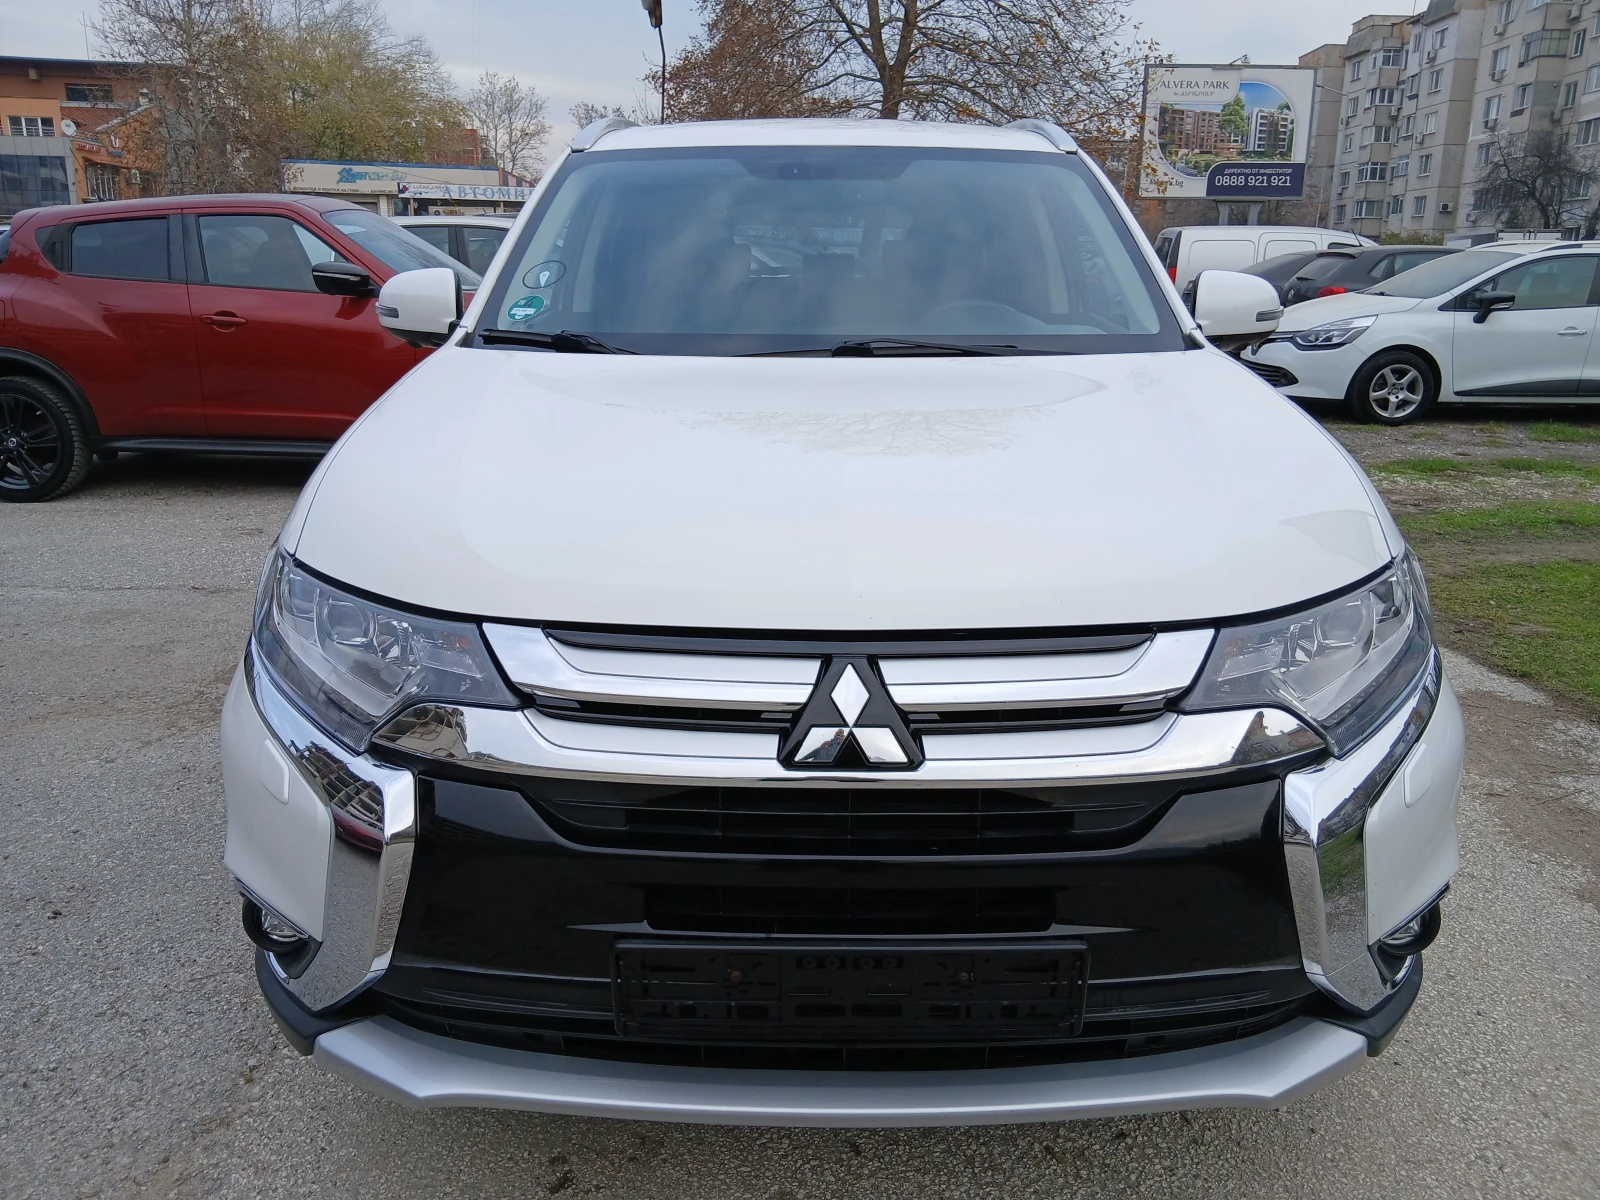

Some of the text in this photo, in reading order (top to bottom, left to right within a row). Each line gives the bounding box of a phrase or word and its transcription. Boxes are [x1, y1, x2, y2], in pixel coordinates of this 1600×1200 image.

[1159, 80, 1230, 90] ALVERA PARK
[1215, 175, 1291, 186] 0888 921 921
